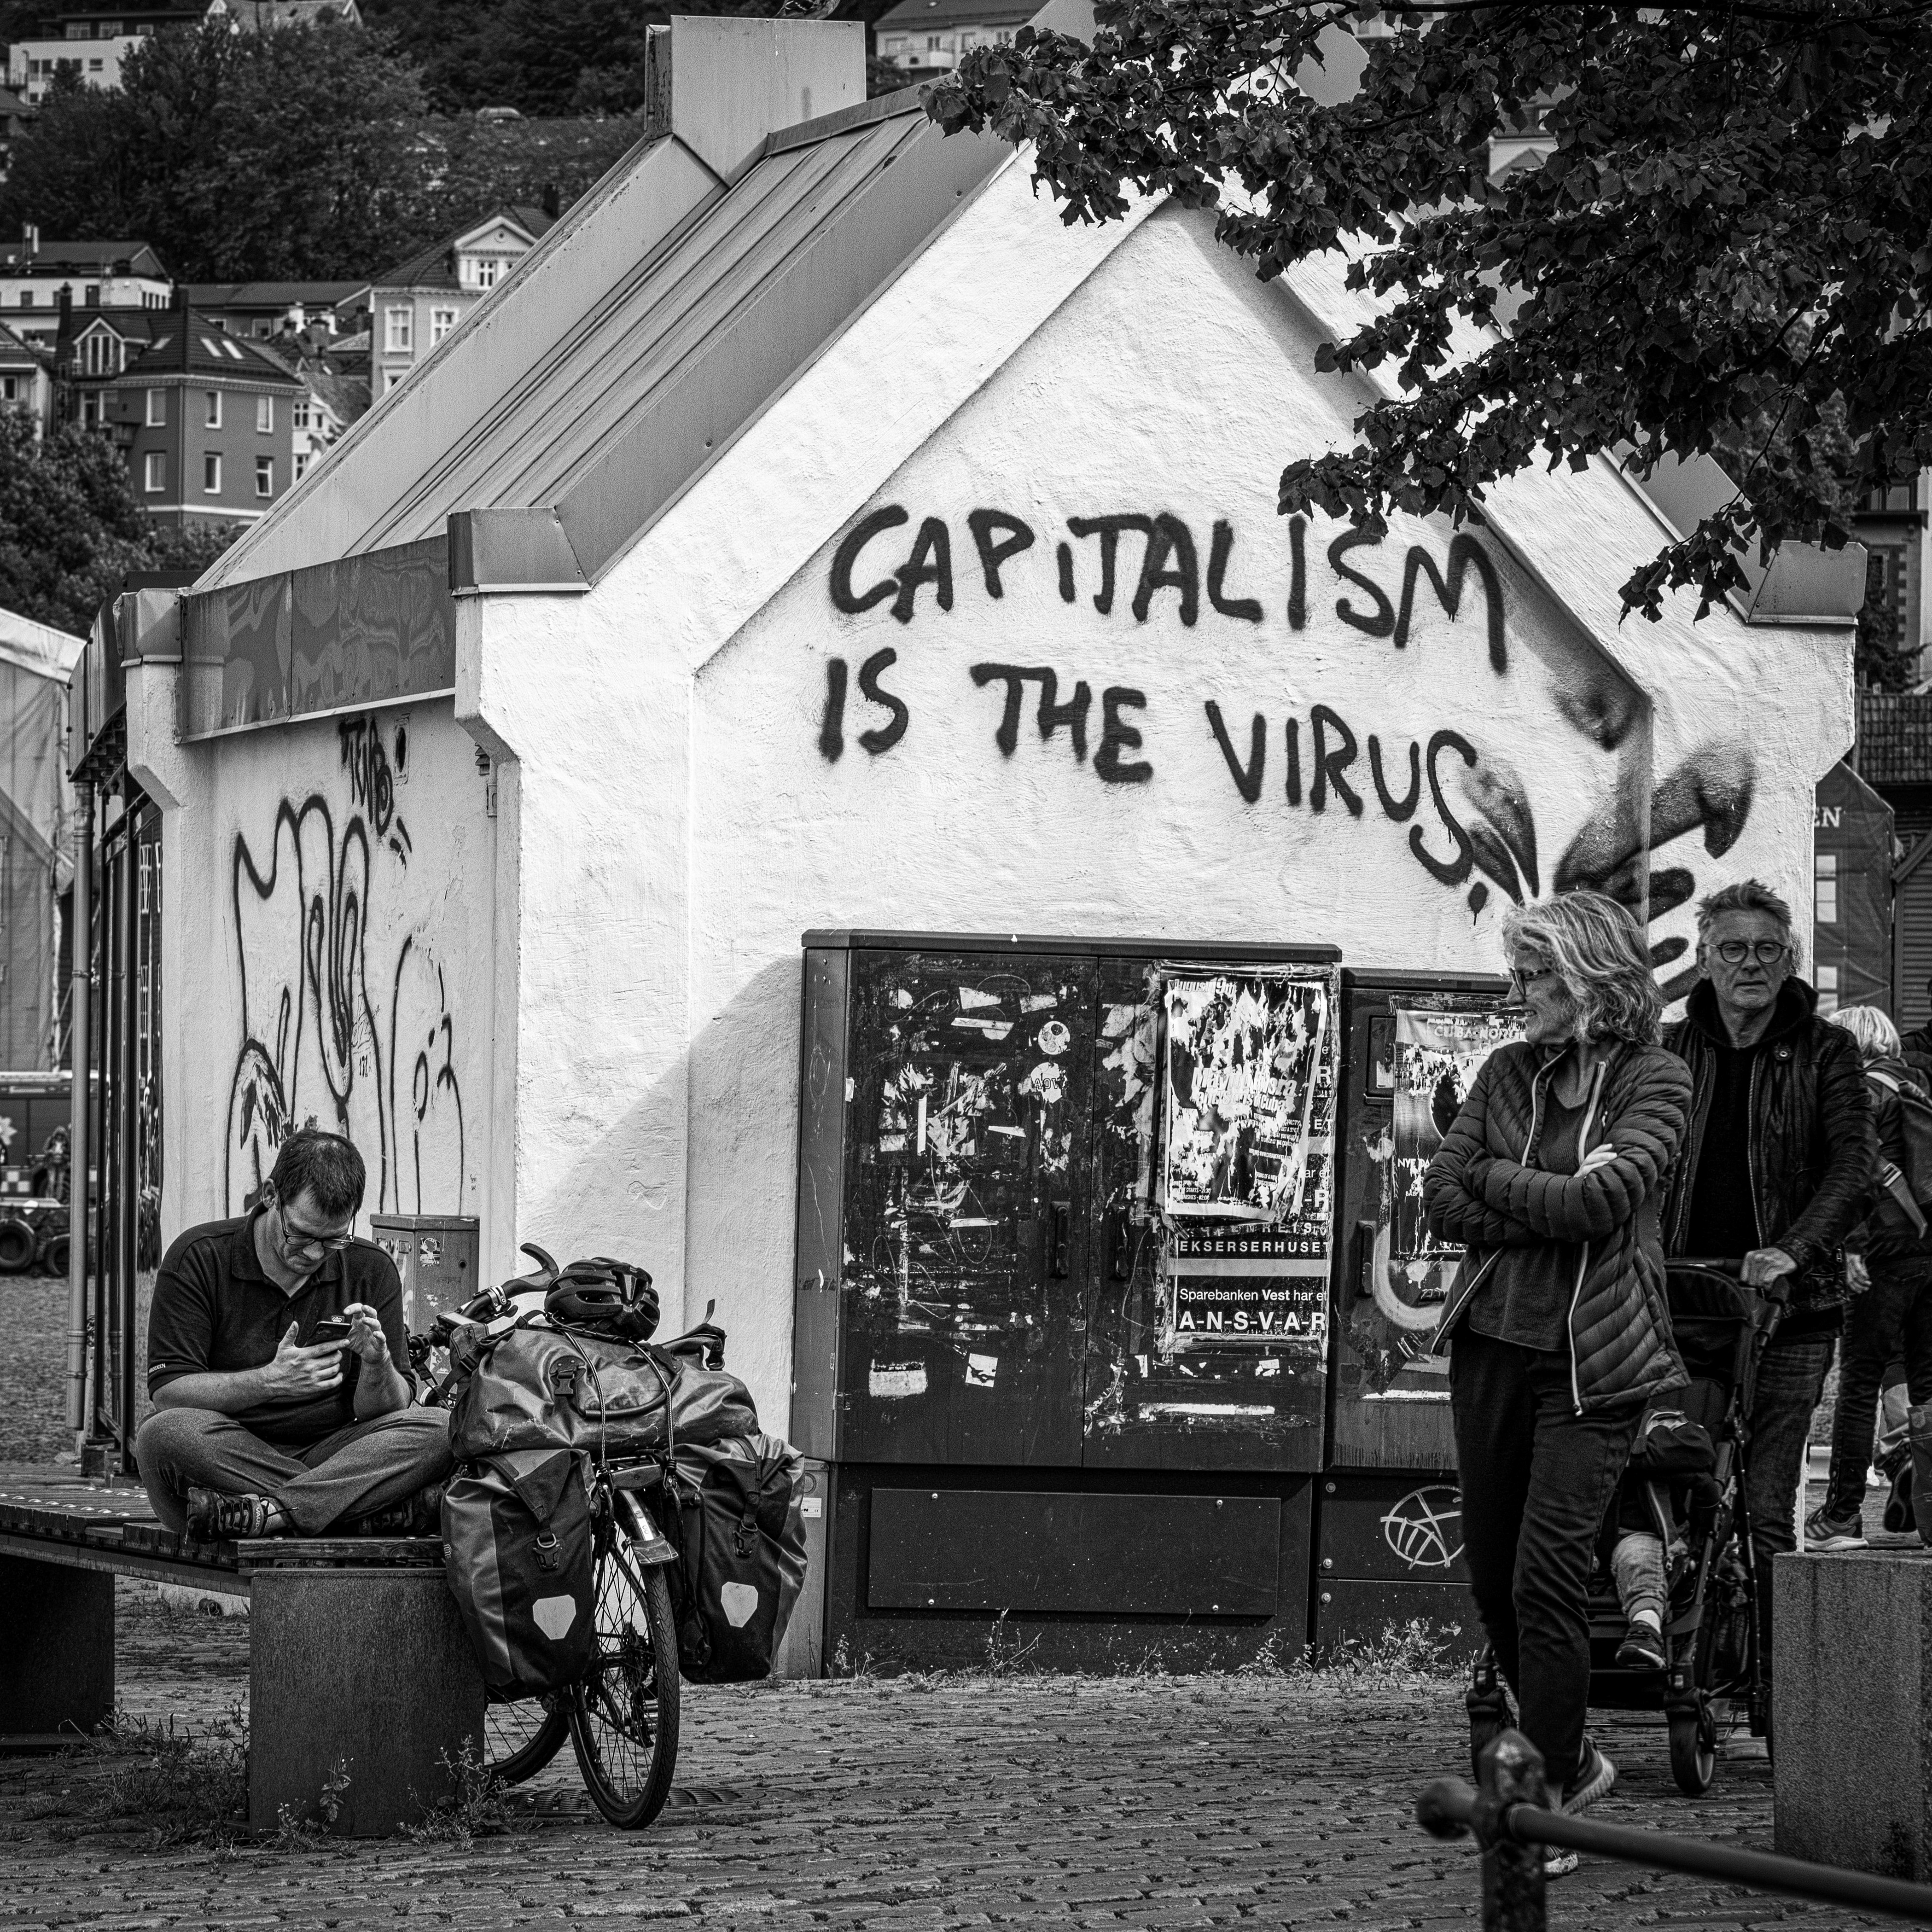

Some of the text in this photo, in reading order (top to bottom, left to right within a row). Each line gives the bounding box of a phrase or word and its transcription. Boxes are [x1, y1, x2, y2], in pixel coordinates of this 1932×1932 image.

[829, 504, 1508, 675] CAPITALISM
[818, 647, 909, 763] IS
[971, 662, 1154, 783] THE
[1398, 1158, 1416, 1168] NYE
[1180, 1241, 1328, 1252] EKSERSERHUSET
[1180, 1289, 1258, 1302] Sparebanken
[1262, 1290, 1290, 1301] Vest
[1294, 1289, 1313, 1301] har
[1179, 1311, 1326, 1331] A-N-S-V-A-R
